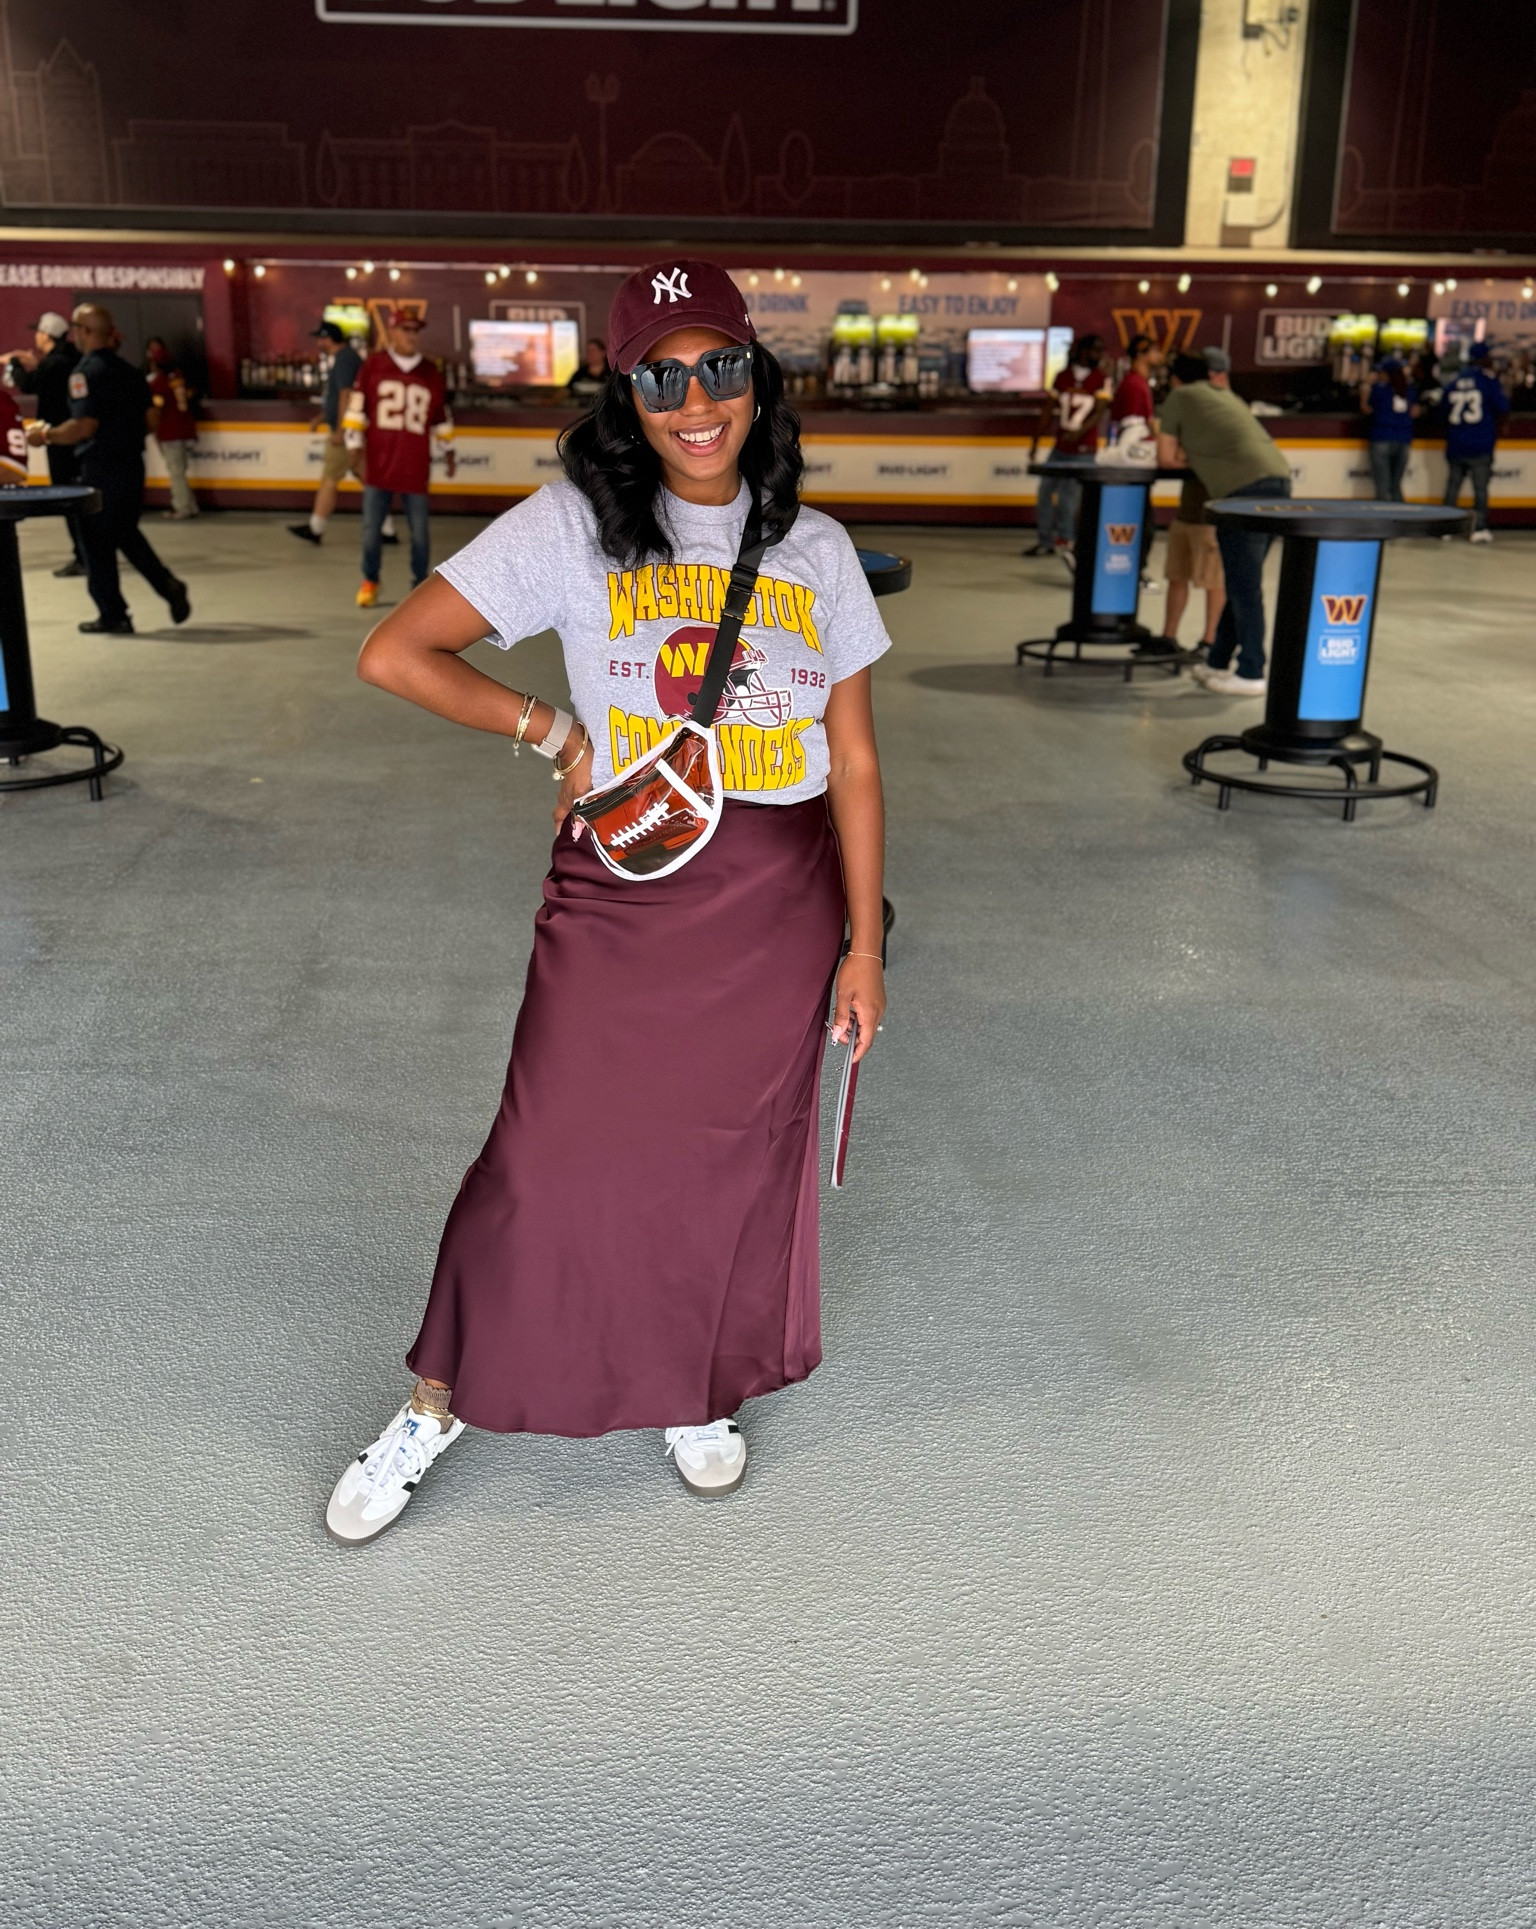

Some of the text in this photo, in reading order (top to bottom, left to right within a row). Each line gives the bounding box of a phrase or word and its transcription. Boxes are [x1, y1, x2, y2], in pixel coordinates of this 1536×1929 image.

[41, 265, 94, 288] DRINK
[95, 266, 206, 289] RESPONSIBLY
[651, 266, 693, 305] NY
[757, 294, 808, 314] DRINK
[898, 295, 1019, 317] EASY TO ENJOY
[1451, 300, 1491, 319] EASY
[1497, 300, 1516, 320] TO
[1274, 316, 1333, 336] BUD
[376, 380, 431, 435] 28
[1060, 392, 1095, 431] 17
[1447, 389, 1483, 425] 73
[609, 659, 827, 690] EST. 1932
